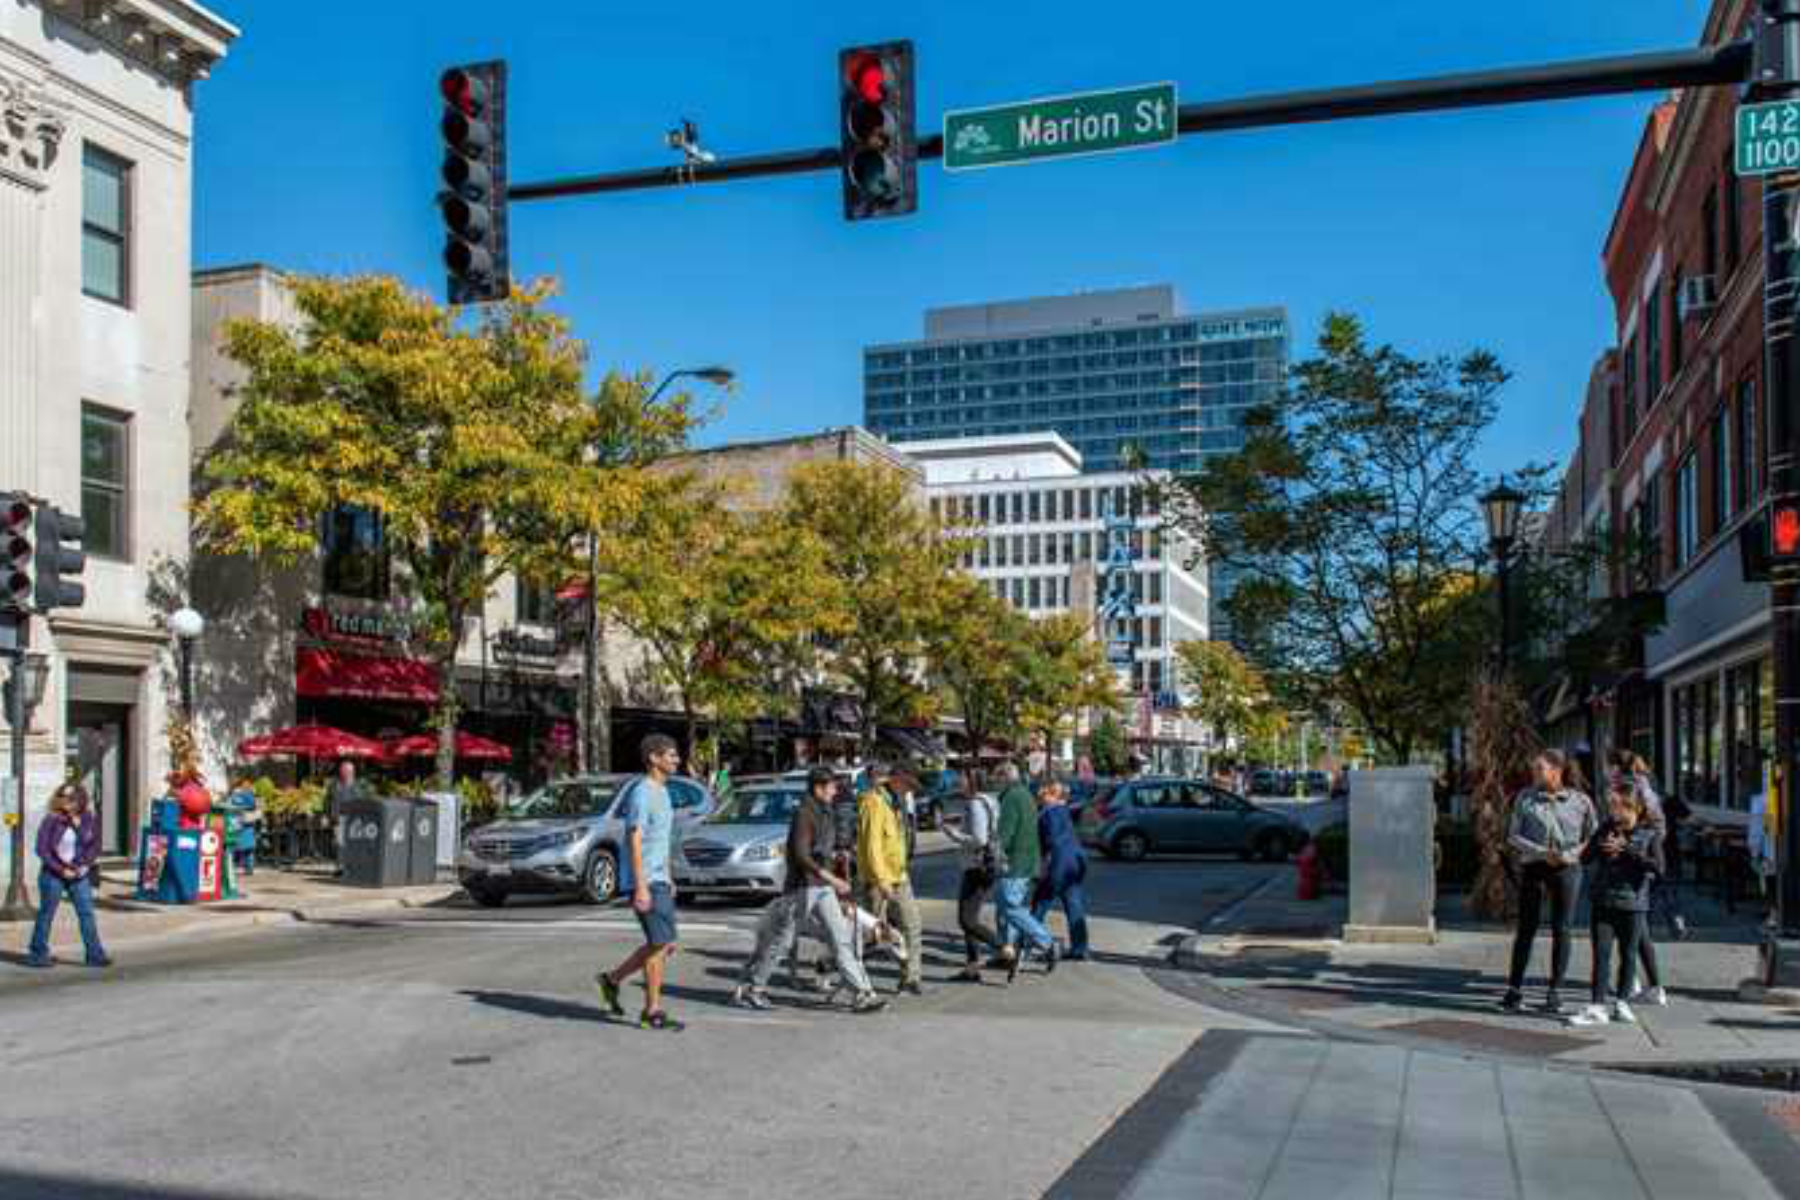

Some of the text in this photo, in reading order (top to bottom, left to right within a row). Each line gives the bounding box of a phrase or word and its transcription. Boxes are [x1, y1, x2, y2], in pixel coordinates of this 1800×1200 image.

[1017, 98, 1165, 149] Marion St
[1749, 103, 1799, 137] 142
[1745, 136, 1799, 168] 1100
